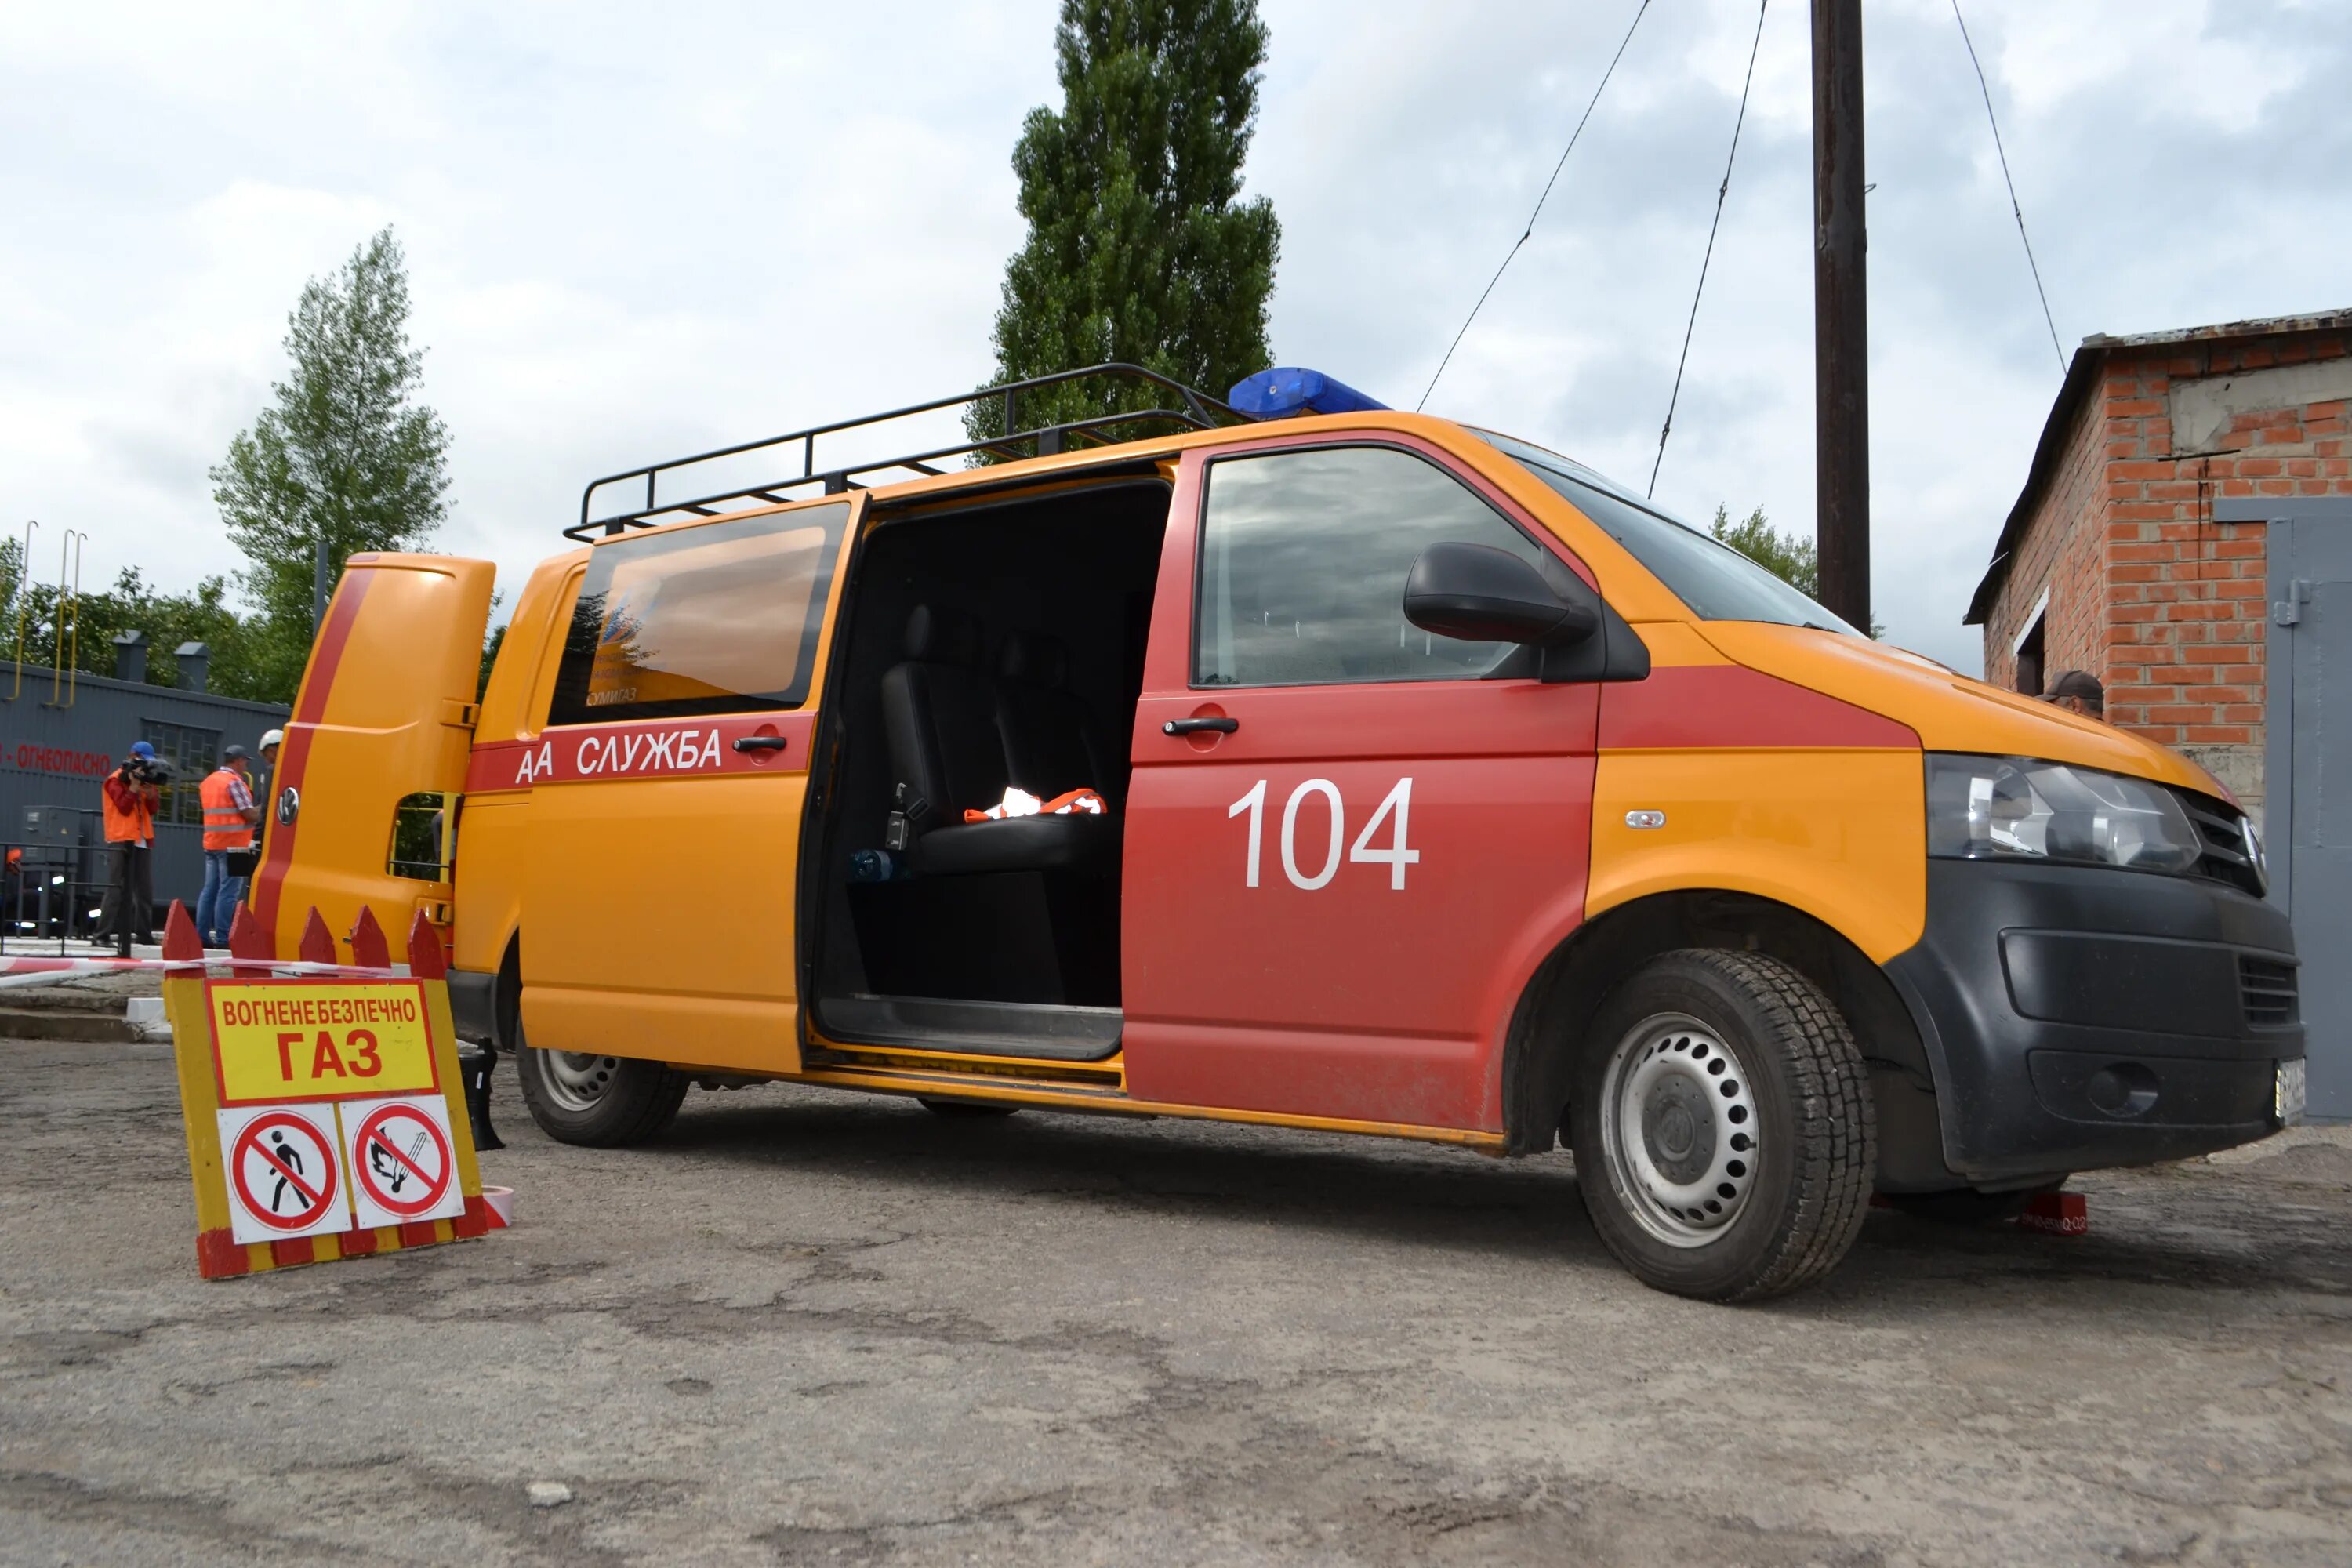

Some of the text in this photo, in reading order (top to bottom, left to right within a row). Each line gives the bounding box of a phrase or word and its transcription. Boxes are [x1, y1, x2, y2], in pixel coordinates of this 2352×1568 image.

[18, 745, 111, 775] ОГНЕОПАСНО
[515, 728, 721, 784] АА СЛУЖБА
[1229, 777, 1420, 891] 104
[223, 998, 415, 1026] ВОГНЕНЕБЕЗПЕЧНО
[277, 1029, 382, 1081] ГАЗ
